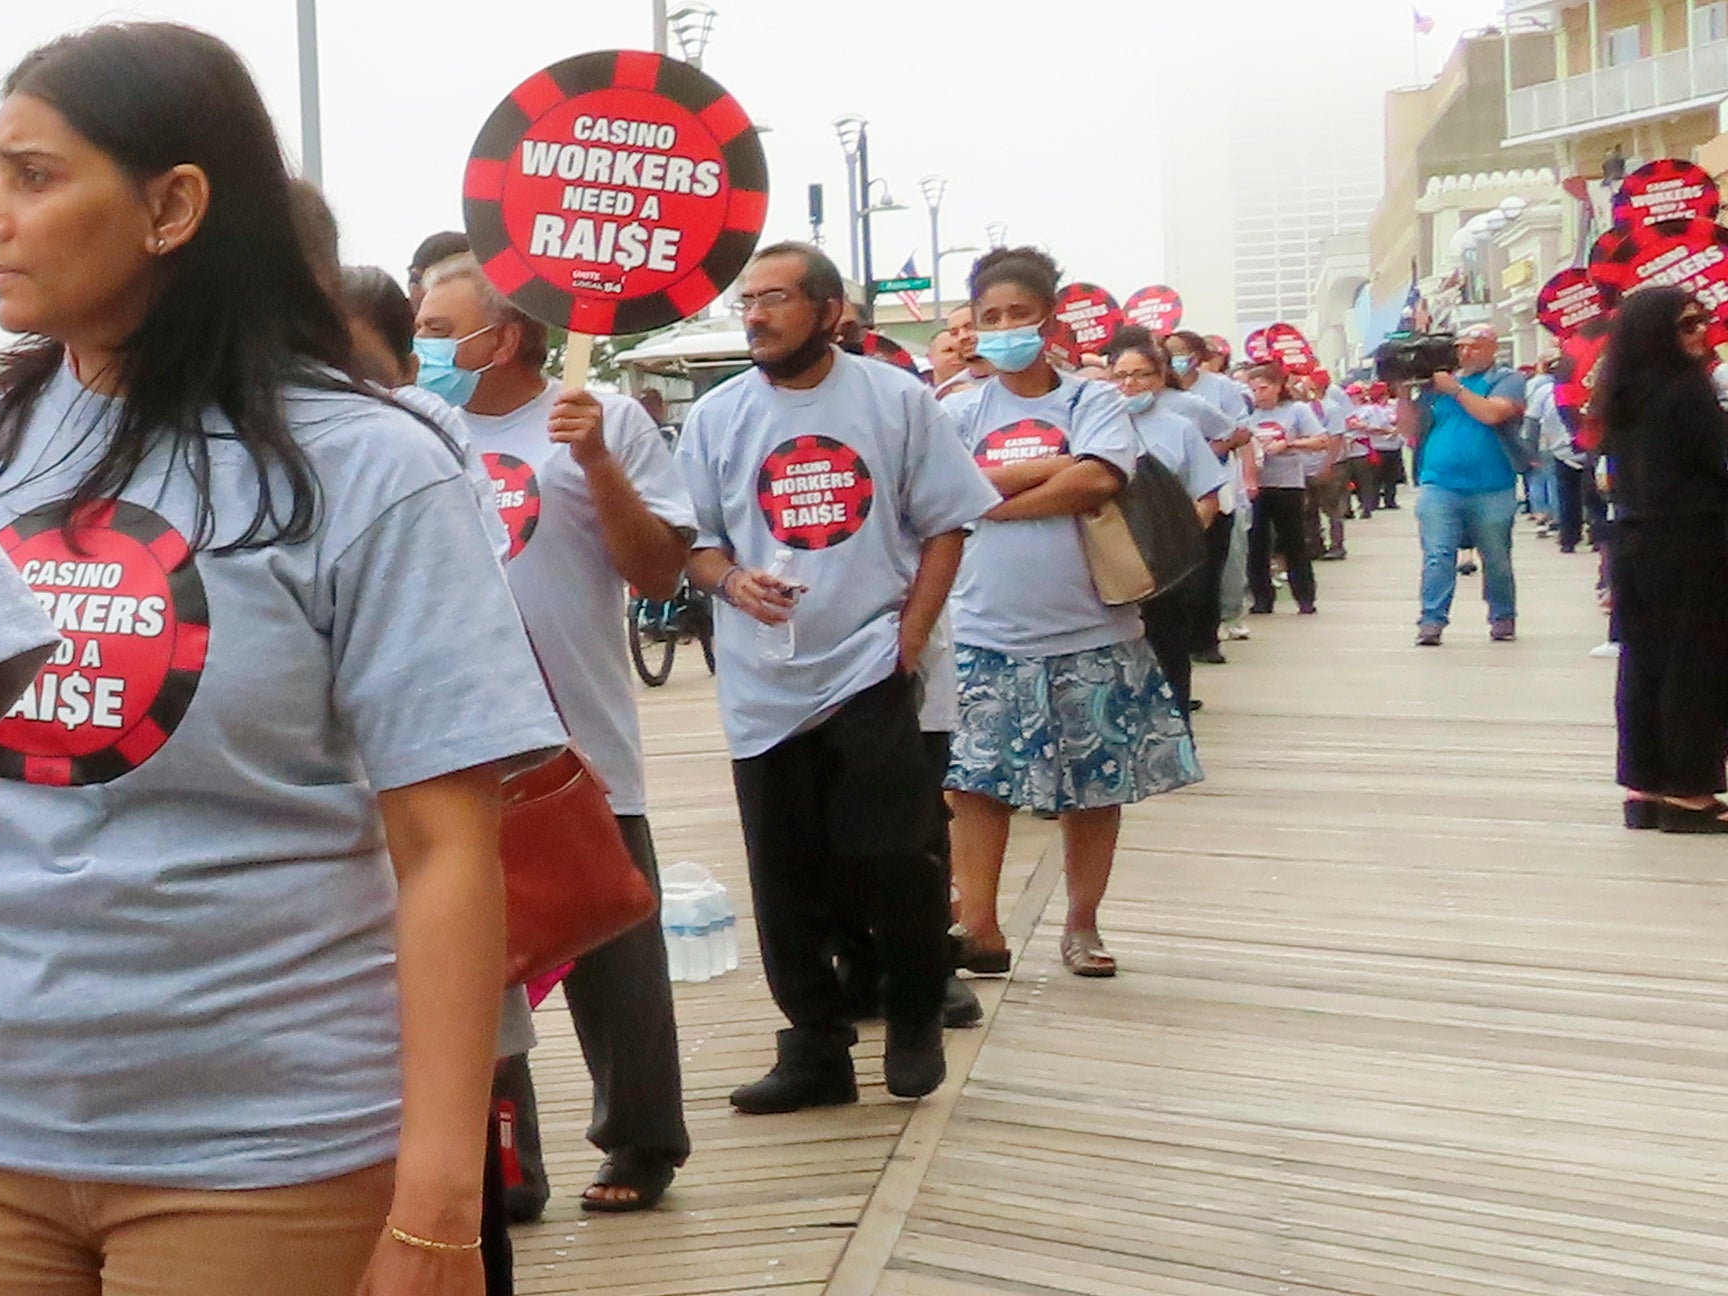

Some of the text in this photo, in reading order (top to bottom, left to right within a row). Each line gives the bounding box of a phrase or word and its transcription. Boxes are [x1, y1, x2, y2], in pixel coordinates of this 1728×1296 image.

[572, 114, 677, 151] CASINO
[520, 140, 722, 198] WORKERS
[561, 186, 661, 221] NEED A
[771, 471, 855, 496] WORKERS
[786, 461, 832, 476] CASINO
[790, 491, 834, 505] NEED A
[21, 559, 124, 589] CASINO
[79, 640, 103, 668] A
[6, 671, 126, 730] AI$E
